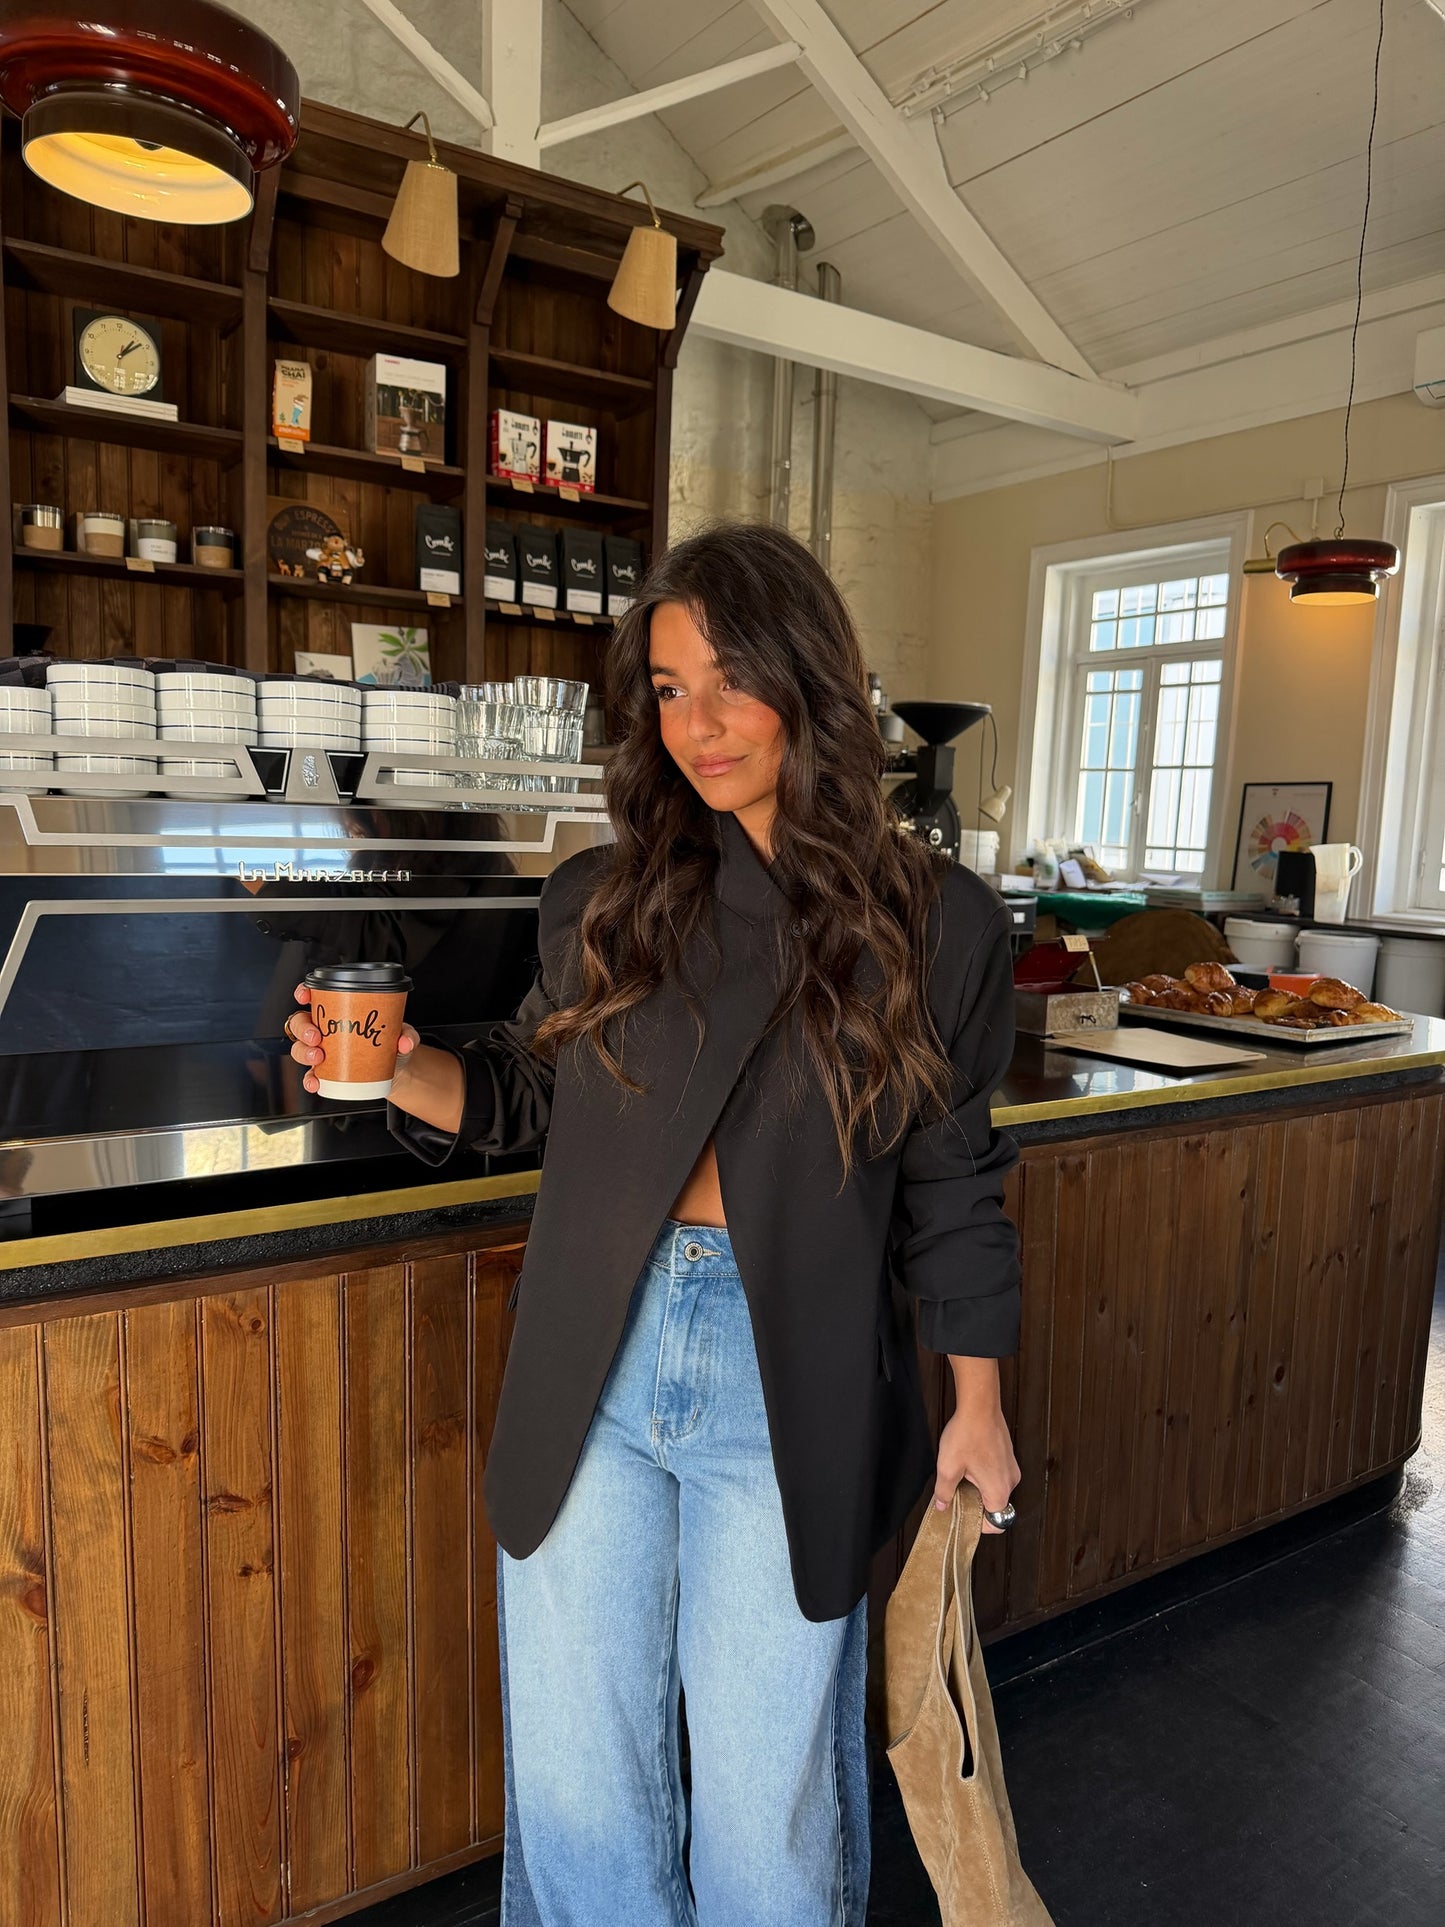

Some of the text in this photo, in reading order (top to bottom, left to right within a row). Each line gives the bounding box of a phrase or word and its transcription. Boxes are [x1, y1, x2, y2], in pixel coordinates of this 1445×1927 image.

[280, 369, 306, 379] CHAI
[294, 510, 338, 534] ESPRESS
[286, 539, 328, 553] MARZOC
[316, 1004, 386, 1047] Combi
